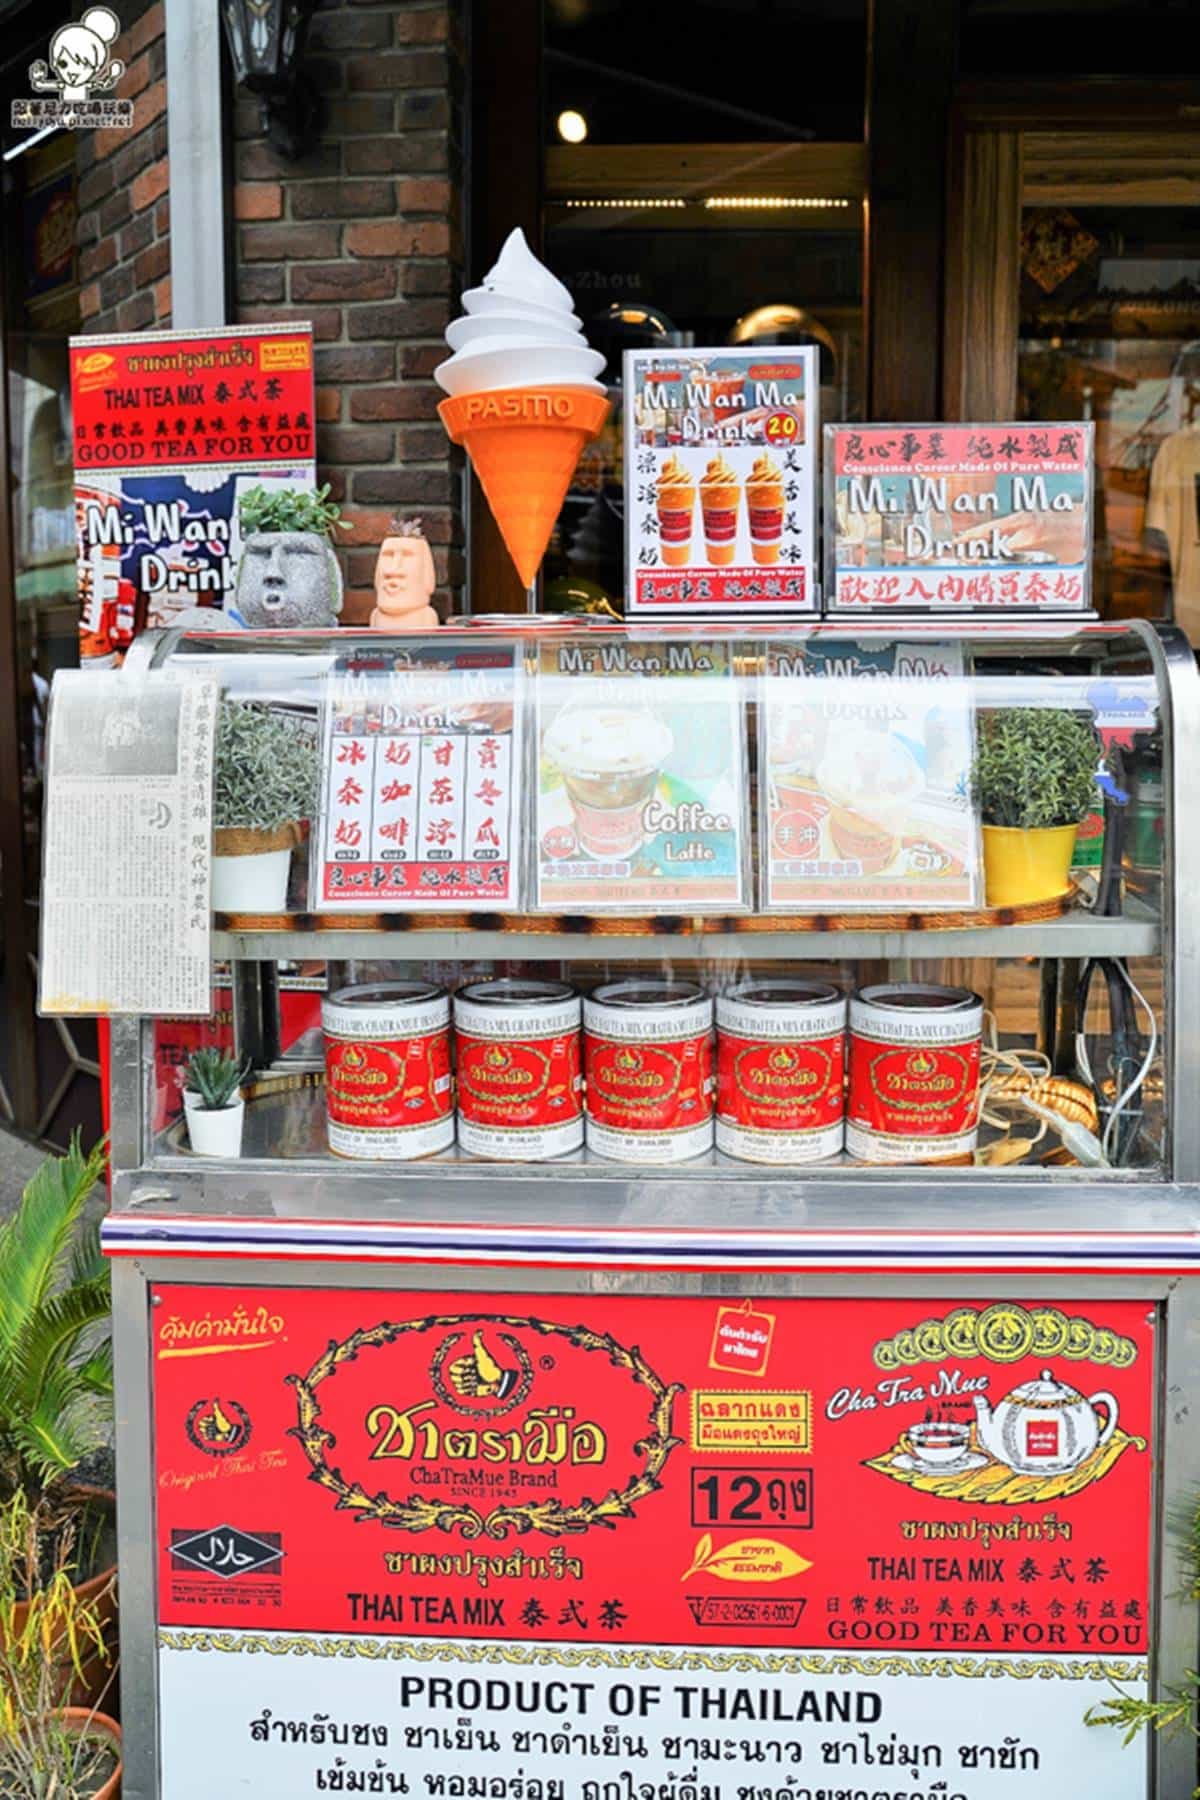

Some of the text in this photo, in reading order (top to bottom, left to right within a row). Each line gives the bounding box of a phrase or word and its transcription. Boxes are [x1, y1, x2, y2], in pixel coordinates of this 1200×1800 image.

[105, 384, 205, 409] THAI TEA MIX
[215, 378, 283, 404] 泰式茶
[644, 381, 799, 409] Mi Wan Ma
[682, 415, 757, 441] Drink
[768, 417, 797, 436] 20
[78, 433, 312, 463] GOOD TEA FOR YOU
[844, 430, 1083, 463] 良心事業 純水製成
[843, 461, 1081, 474] Conscience Career Made Of Pure Water
[847, 475, 1074, 514] Mi Wan Ma
[87, 502, 229, 546] Mi Wan
[905, 525, 1015, 560] Drink
[140, 554, 236, 593] Drink
[559, 646, 714, 673] Mi Wan Ma
[335, 740, 367, 847] 冰泰奶
[379, 740, 413, 847] 奶咖啡
[642, 801, 732, 833] Coffee
[664, 843, 715, 862] Latte
[160, 1303, 285, 1349] คุ้มค่ามั่นใจ
[701, 1401, 801, 1418] ฉลากแดง
[826, 1368, 990, 1421] Cha Tra Mue
[365, 1399, 608, 1467] ชาตรามือ
[159, 1449, 288, 1494] Original Thai Tea
[410, 1466, 558, 1488] ChaTraMue Brand
[450, 1487, 486, 1498] SINCE
[900, 1513, 1073, 1549] ชาผงปรุงสำเร็จ
[198, 1535, 255, 1566] حلال
[384, 1546, 583, 1588] ชาผงปรุงสำเร็จ
[867, 1556, 1004, 1583] THAI TEA MIX
[1016, 1556, 1110, 1585] 泰式茶
[347, 1593, 506, 1626] THAI TEA MIX
[518, 1598, 628, 1631] 泰式茶
[827, 1597, 1143, 1621] 日常飲品 美香美味 含有益處
[828, 1620, 1142, 1646] GOOD TEA FOR YOU
[401, 1676, 883, 1723] PRODUCT OF THAILAND
[249, 1709, 1041, 1780] สำหรับชง ชาเย็น ชาดำเย็น ชามะนาว ชาไข่มุก ชาชัก
[316, 1757, 410, 1795] เข้มข้น
[423, 1768, 564, 1800] หอมอร่อย
[581, 1766, 721, 1800] ถกใจผ้ดื่ม
